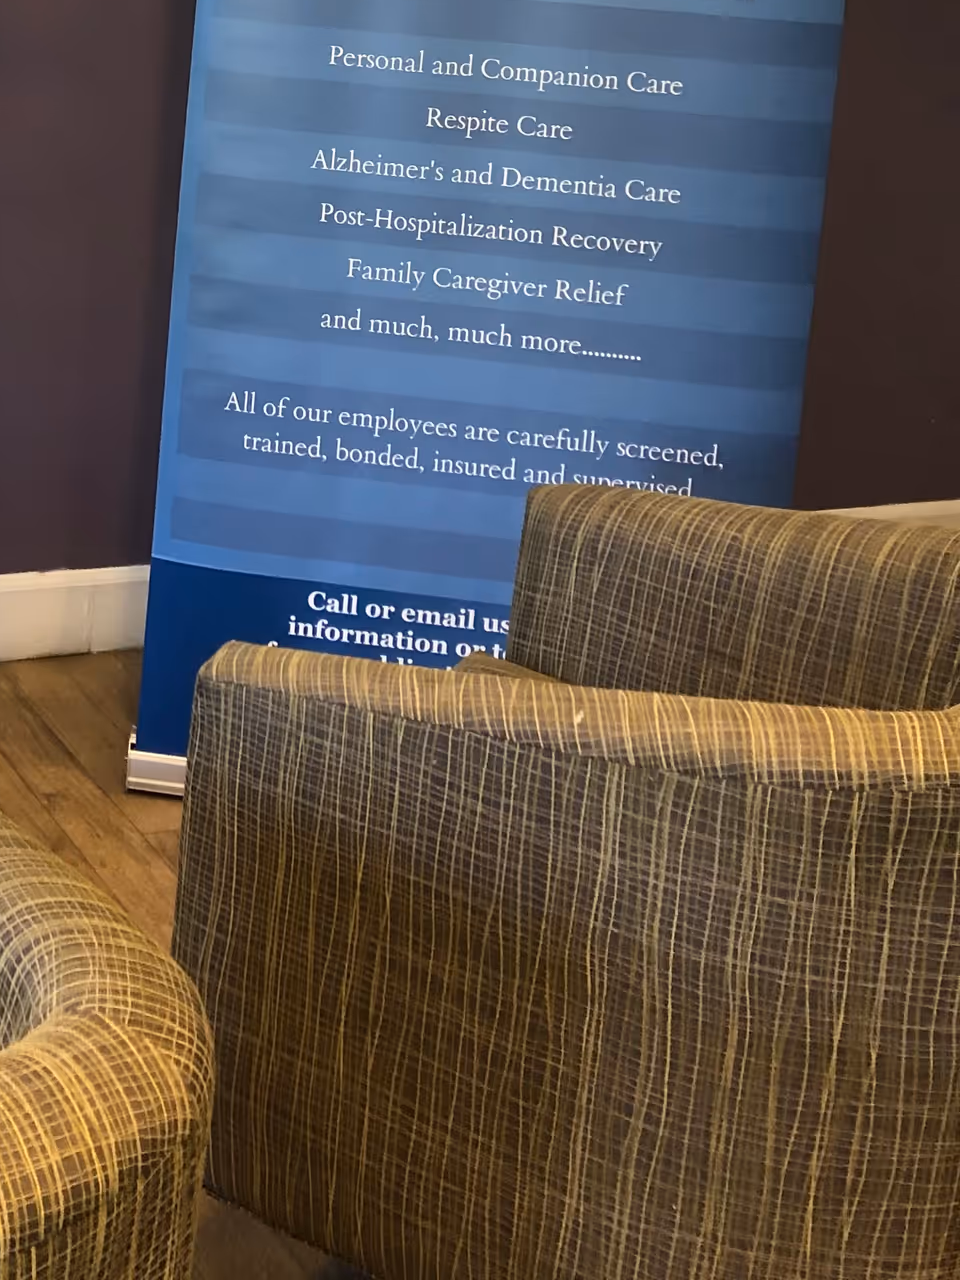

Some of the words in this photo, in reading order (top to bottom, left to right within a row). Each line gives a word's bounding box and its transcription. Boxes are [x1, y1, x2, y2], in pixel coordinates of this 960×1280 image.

[329, 46, 424, 72] Personal
[432, 54, 473, 76] and
[481, 59, 618, 92] Companion
[627, 72, 683, 95] Care
[426, 107, 508, 138] Respite
[517, 116, 572, 139] Care
[310, 148, 443, 181] Alzheimer's
[451, 162, 493, 185] and
[501, 167, 616, 198] Dementia
[625, 180, 680, 203] Care
[320, 203, 543, 244] Post-Hospitalization
[552, 226, 663, 261] Recovery
[347, 258, 426, 291] Family
[433, 268, 547, 300] Caregiver
[554, 279, 629, 305] Relief
[321, 308, 361, 330] and
[369, 315, 439, 342] much,
[448, 323, 512, 347] much
[224, 391, 255, 414] All
[263, 397, 290, 418] of
[293, 406, 332, 423] our
[339, 408, 457, 439] employees
[464, 425, 499, 442] are
[507, 428, 609, 460] carefully
[616, 442, 723, 470] screened,
[244, 432, 327, 461] trained,
[336, 438, 424, 473] bonded,
[433, 450, 516, 480] insured
[523, 464, 565, 487] and
[288, 615, 448, 655] information
[308, 591, 358, 615] Call
[365, 603, 395, 619] or
[401, 608, 475, 630] email
[483, 617, 510, 635] us
